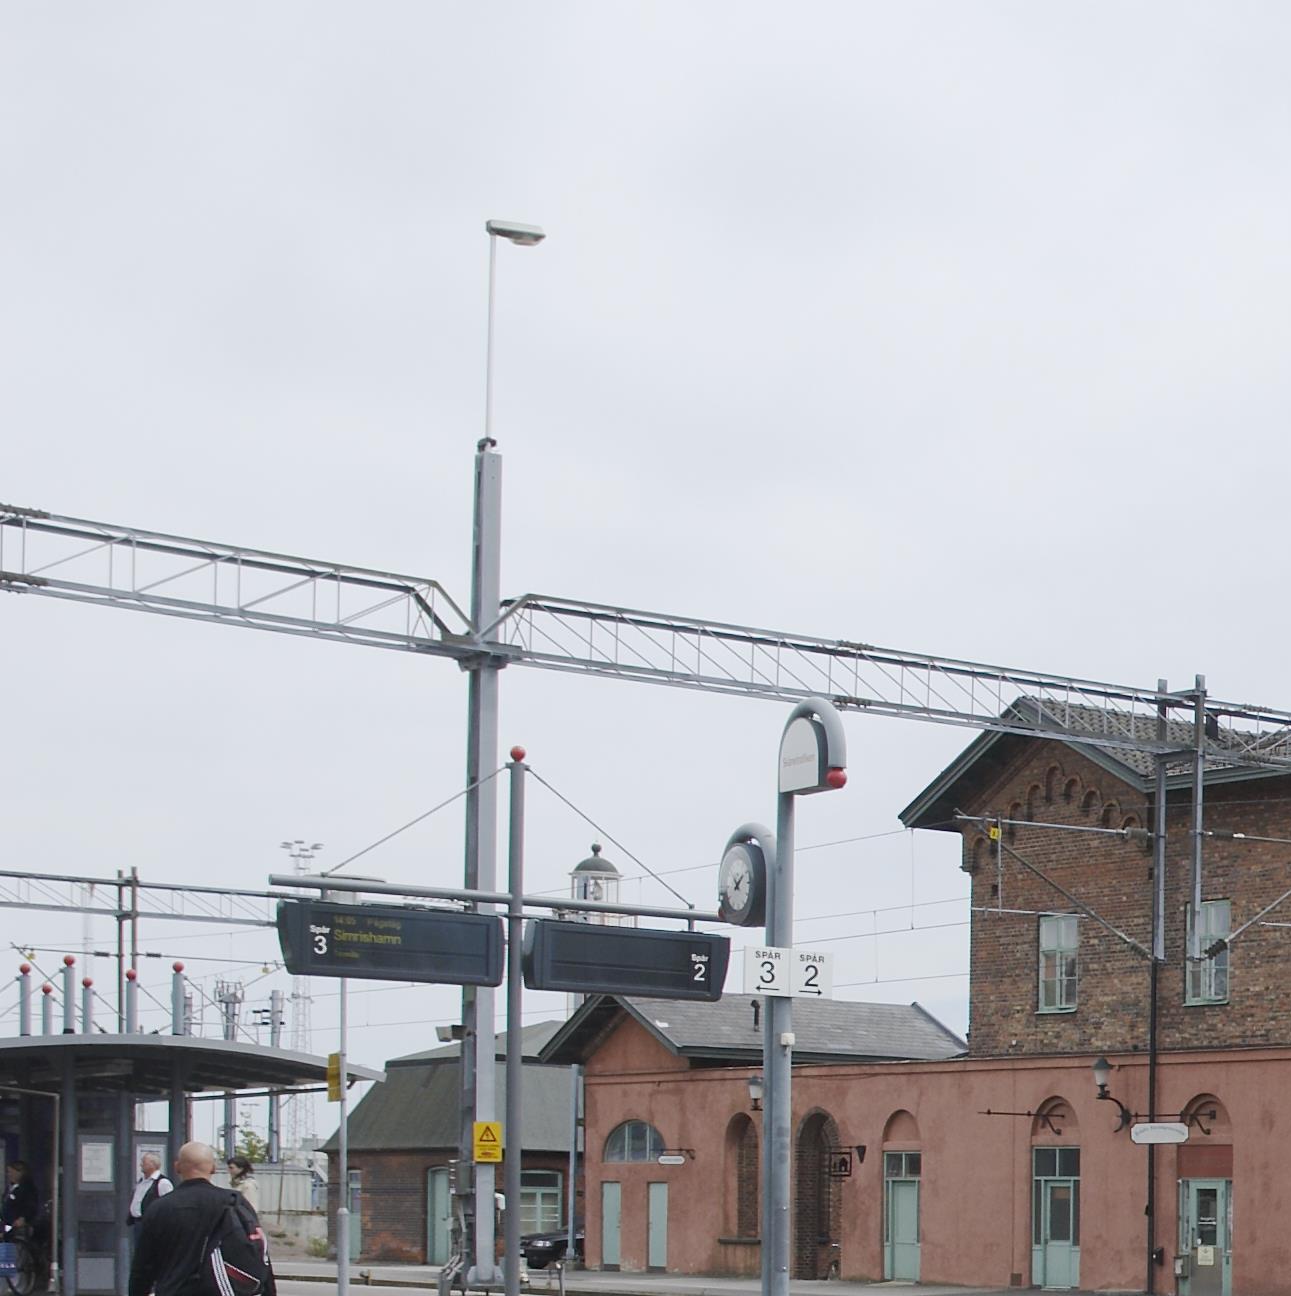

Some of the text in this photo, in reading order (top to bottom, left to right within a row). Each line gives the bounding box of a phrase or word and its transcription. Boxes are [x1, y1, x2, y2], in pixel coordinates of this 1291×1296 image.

[309, 924, 331, 935] Spår
[334, 929, 401, 944] Simrishamn
[314, 935, 328, 955] 3
[755, 950, 781, 960] SPÅR
[799, 952, 825, 963] SPÅR
[694, 963, 705, 981] 2
[760, 961, 775, 983] 3
[804, 965, 818, 987] 2
